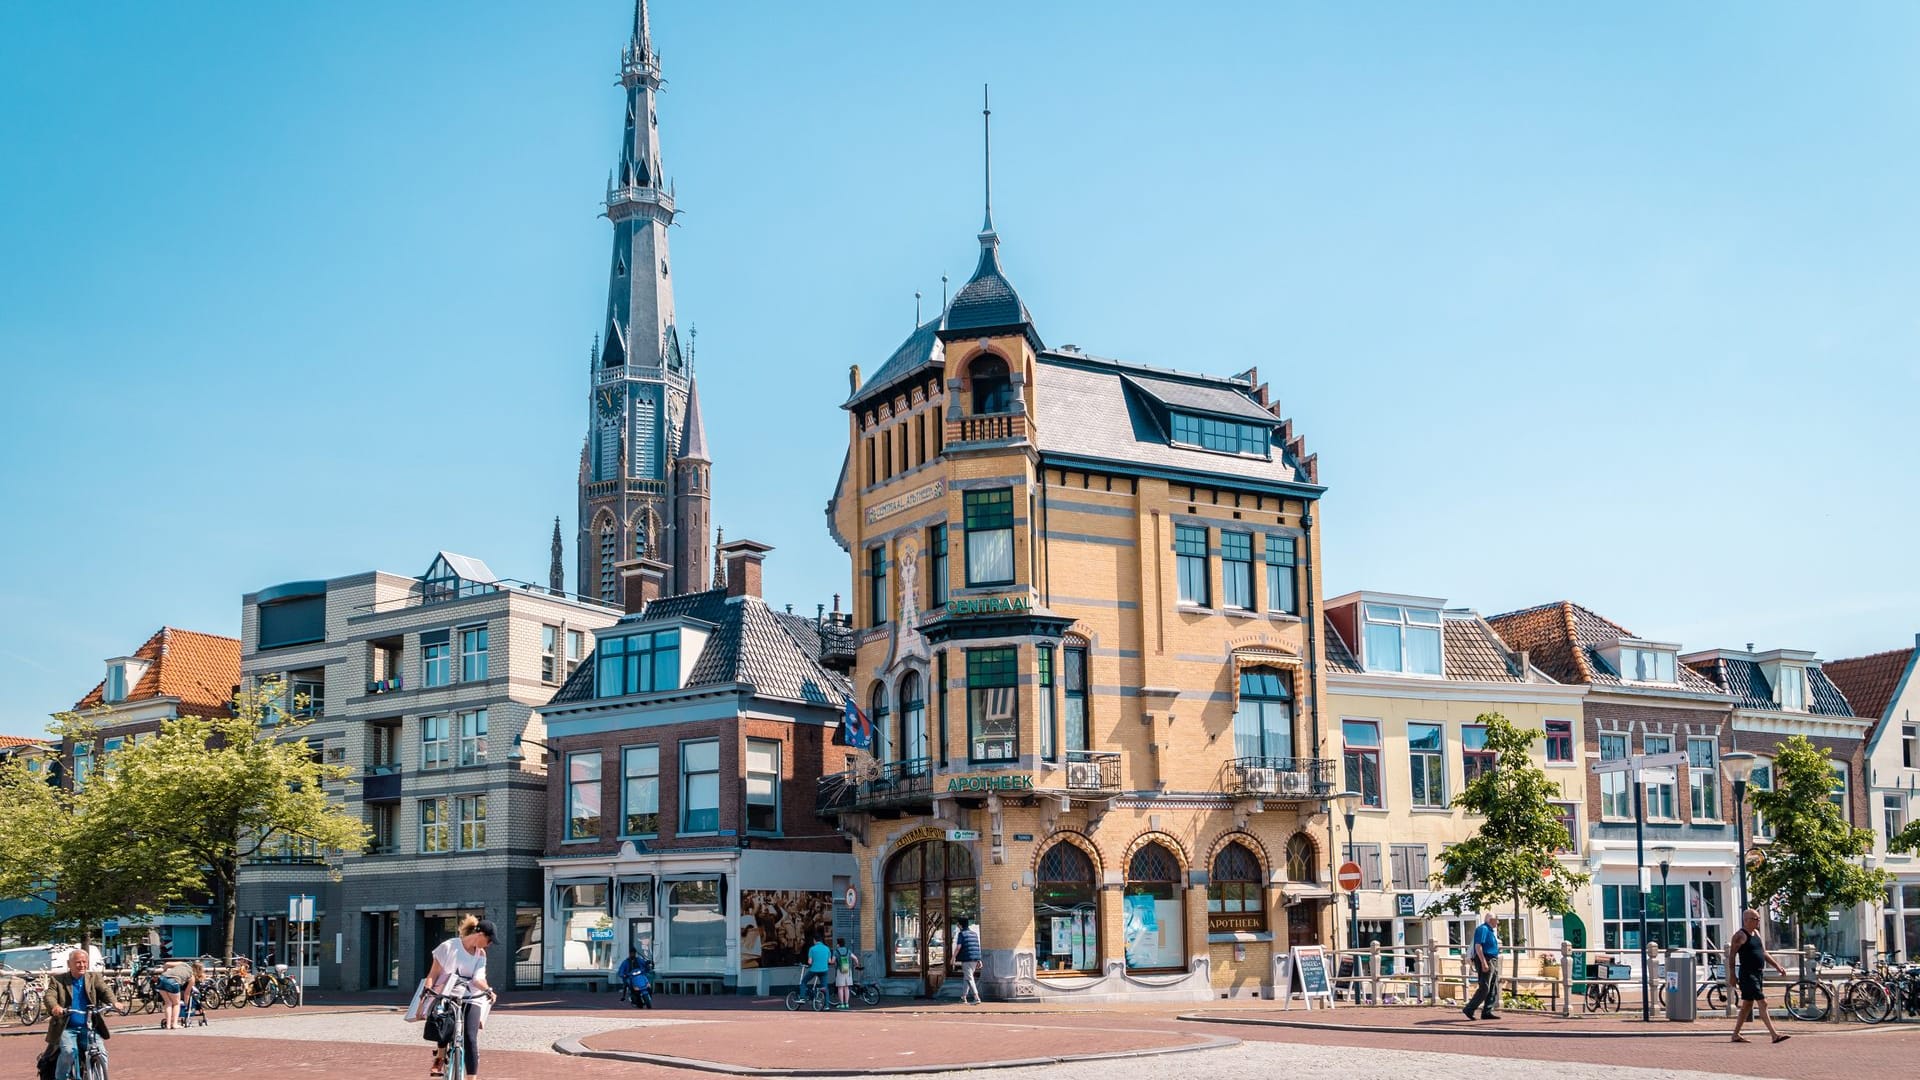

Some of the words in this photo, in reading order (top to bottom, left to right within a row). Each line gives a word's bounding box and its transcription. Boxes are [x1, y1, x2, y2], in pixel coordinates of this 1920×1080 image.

[945, 597, 1033, 614] CENTRAAL
[947, 774, 1034, 792] APOTHEEK
[1208, 918, 1260, 929] APOTHEEK
